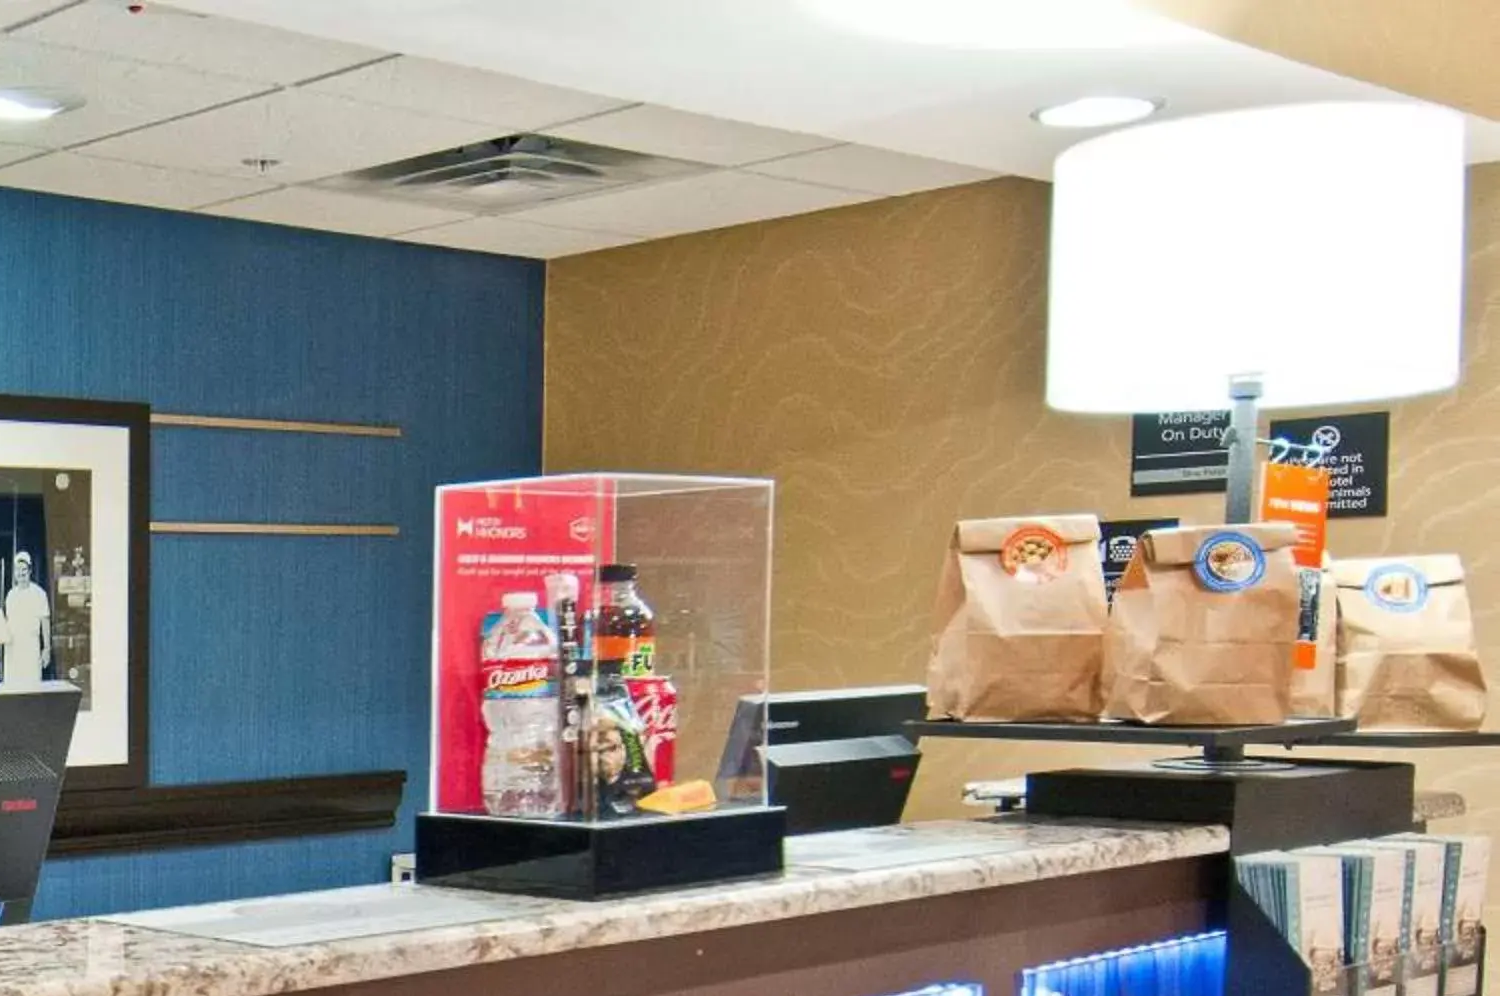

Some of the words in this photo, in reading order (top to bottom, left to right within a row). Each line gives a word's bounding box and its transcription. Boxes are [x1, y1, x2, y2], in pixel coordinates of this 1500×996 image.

[1161, 428, 1185, 442] On
[1189, 426, 1227, 447] Duty
[1341, 453, 1363, 463] not
[1351, 464, 1365, 474] in
[1329, 475, 1353, 487] otel
[1325, 497, 1368, 510] mitted
